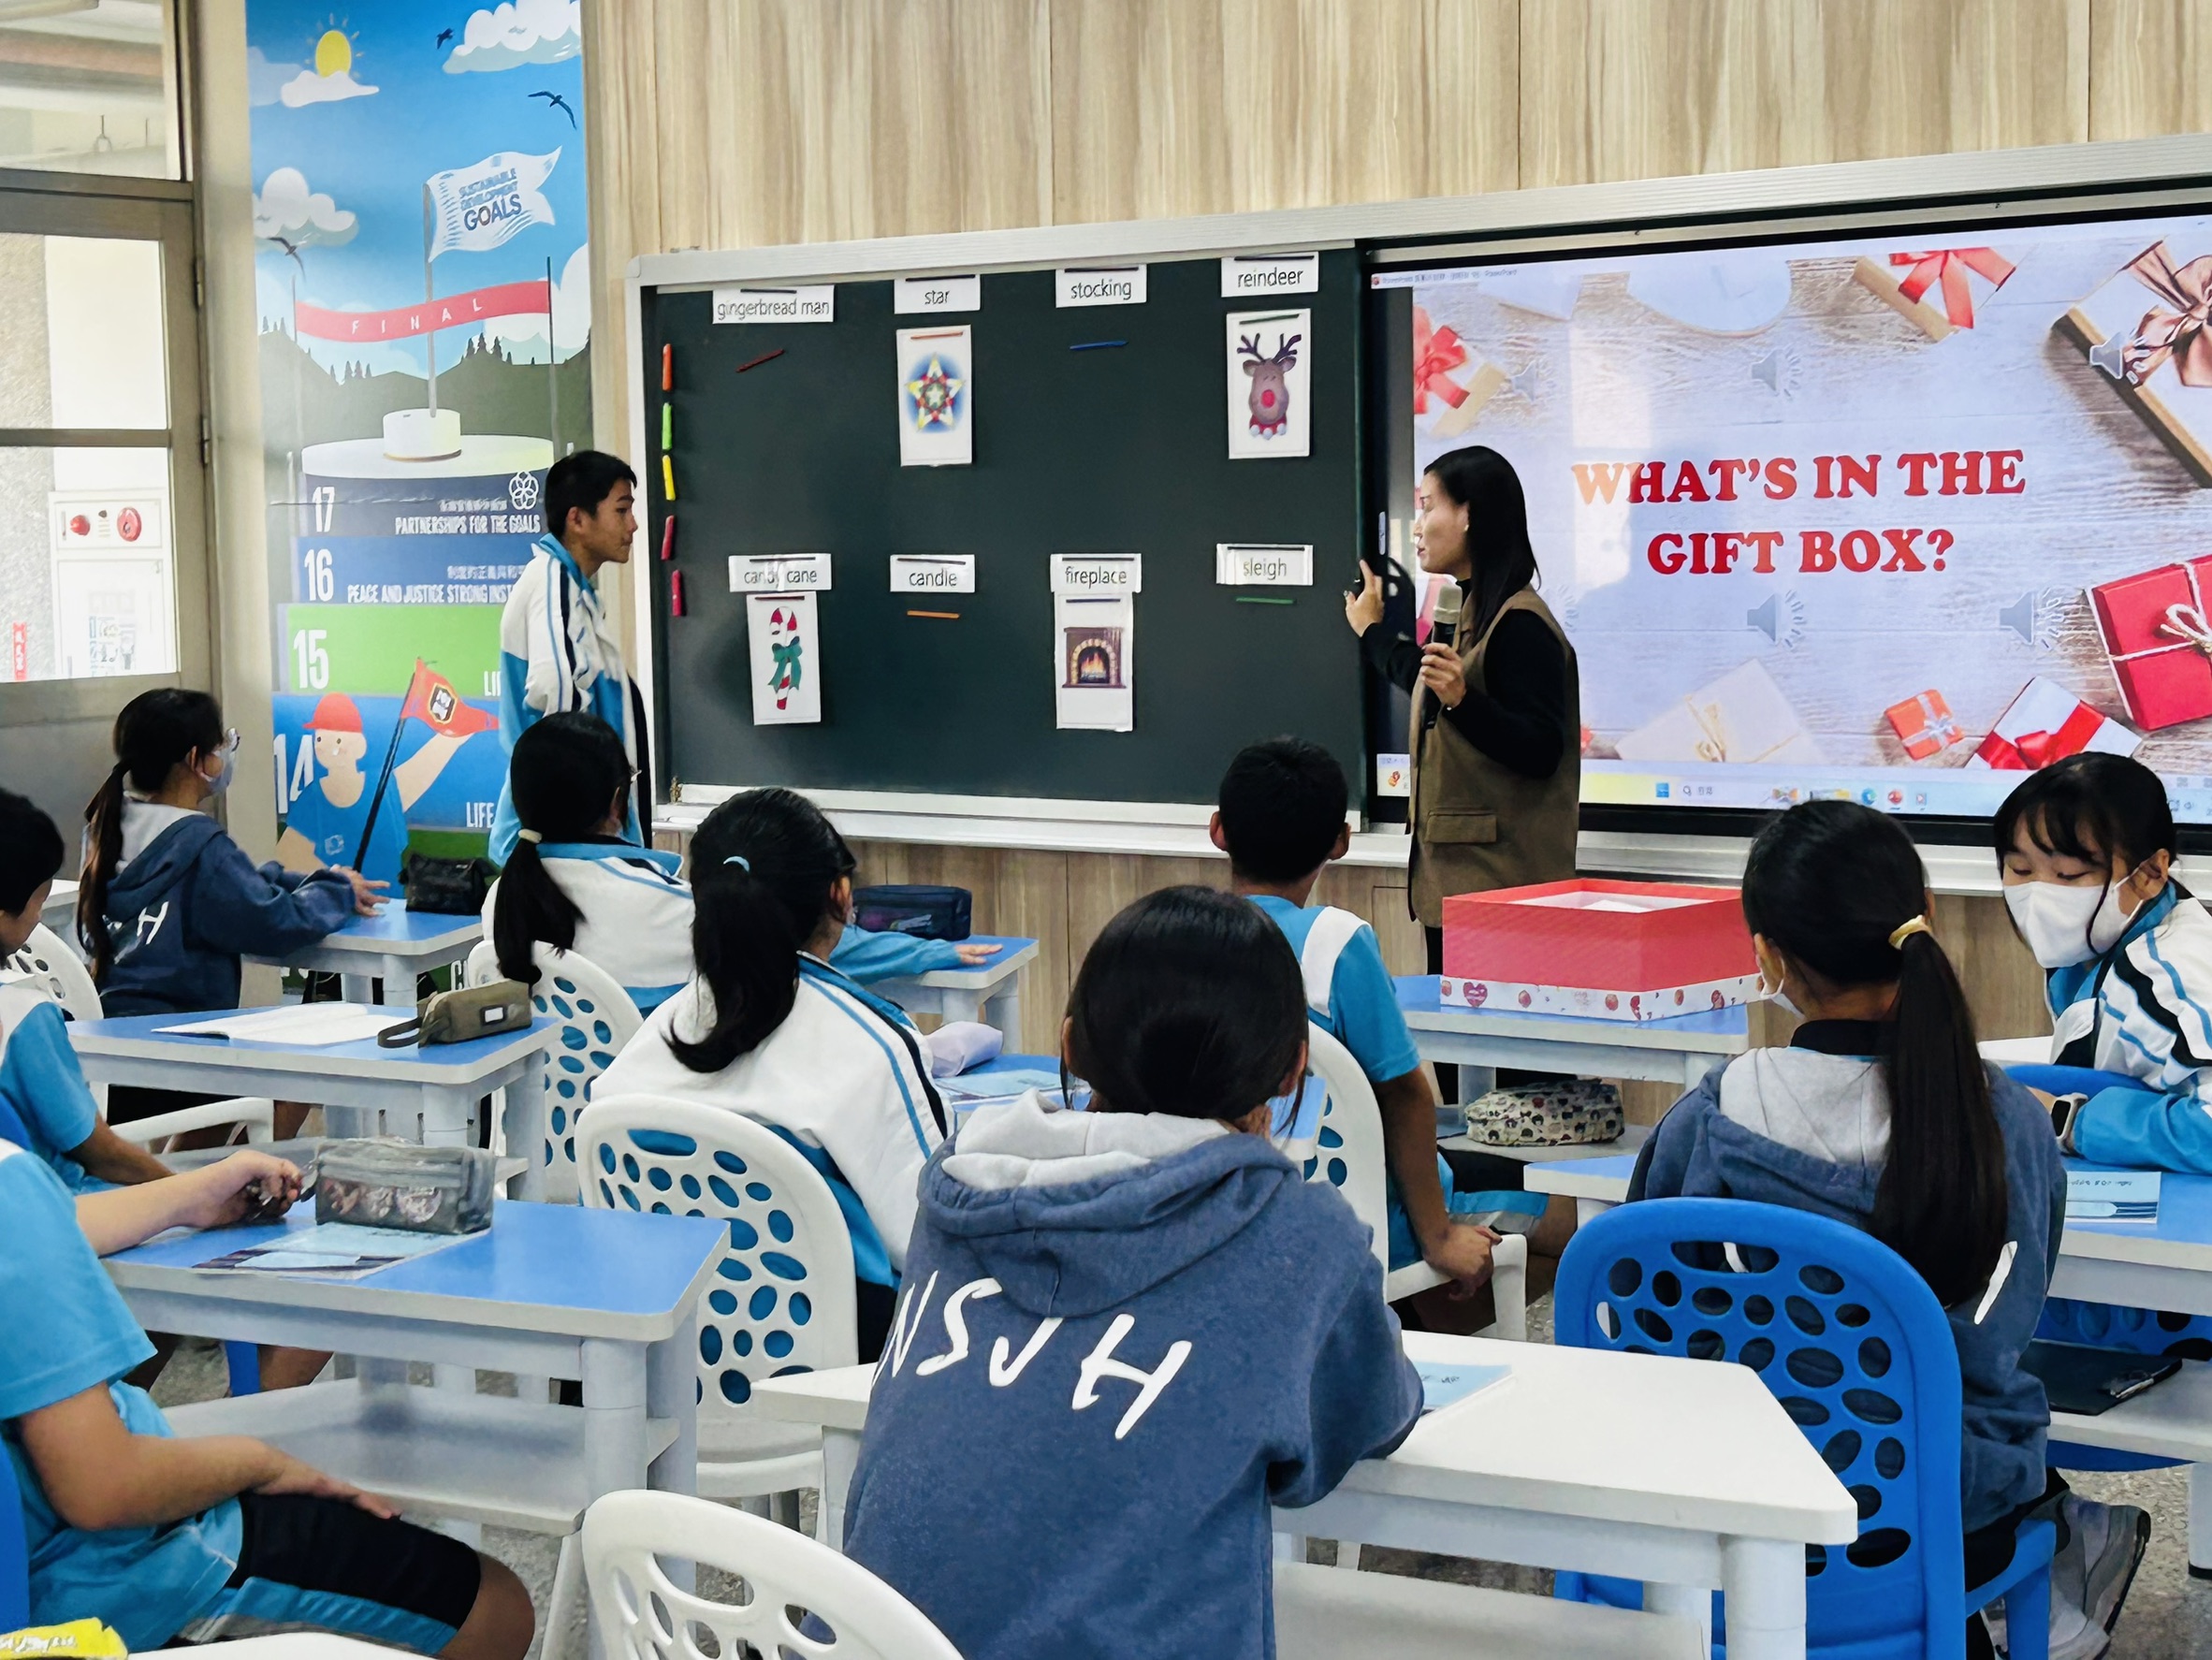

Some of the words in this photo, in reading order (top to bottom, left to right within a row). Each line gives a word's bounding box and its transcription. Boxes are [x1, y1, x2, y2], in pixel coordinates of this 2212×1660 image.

[464, 194, 522, 231] GOALS
[1237, 267, 1303, 287] reindeer
[924, 289, 951, 305] star
[1070, 278, 1132, 300] stocking
[352, 298, 483, 335] FINAL
[718, 298, 797, 321] gingerbread
[801, 299, 830, 315] man
[1572, 458, 1797, 504] WHAT'S
[1813, 454, 1882, 498] IN
[1897, 449, 2026, 496] THE
[312, 486, 335, 532] 17
[395, 516, 467, 534] PARTNERSHIPS
[469, 516, 488, 534] FOR
[491, 515, 508, 533] THE
[509, 515, 541, 533] GOALS
[1647, 531, 1783, 575] GIFT
[1798, 529, 1954, 573] BOX?
[304, 548, 334, 602] 16
[787, 570, 818, 583] cane
[909, 568, 957, 587] candle
[1065, 566, 1128, 589] fireplace
[1243, 557, 1288, 580] sleigh
[347, 584, 379, 604] PEACE
[381, 584, 402, 604] AND
[403, 584, 444, 604] JUSTICE
[446, 584, 488, 604] STRONG
[293, 629, 329, 690] 15
[273, 734, 313, 813] 14
[466, 801, 495, 828] LIFE
